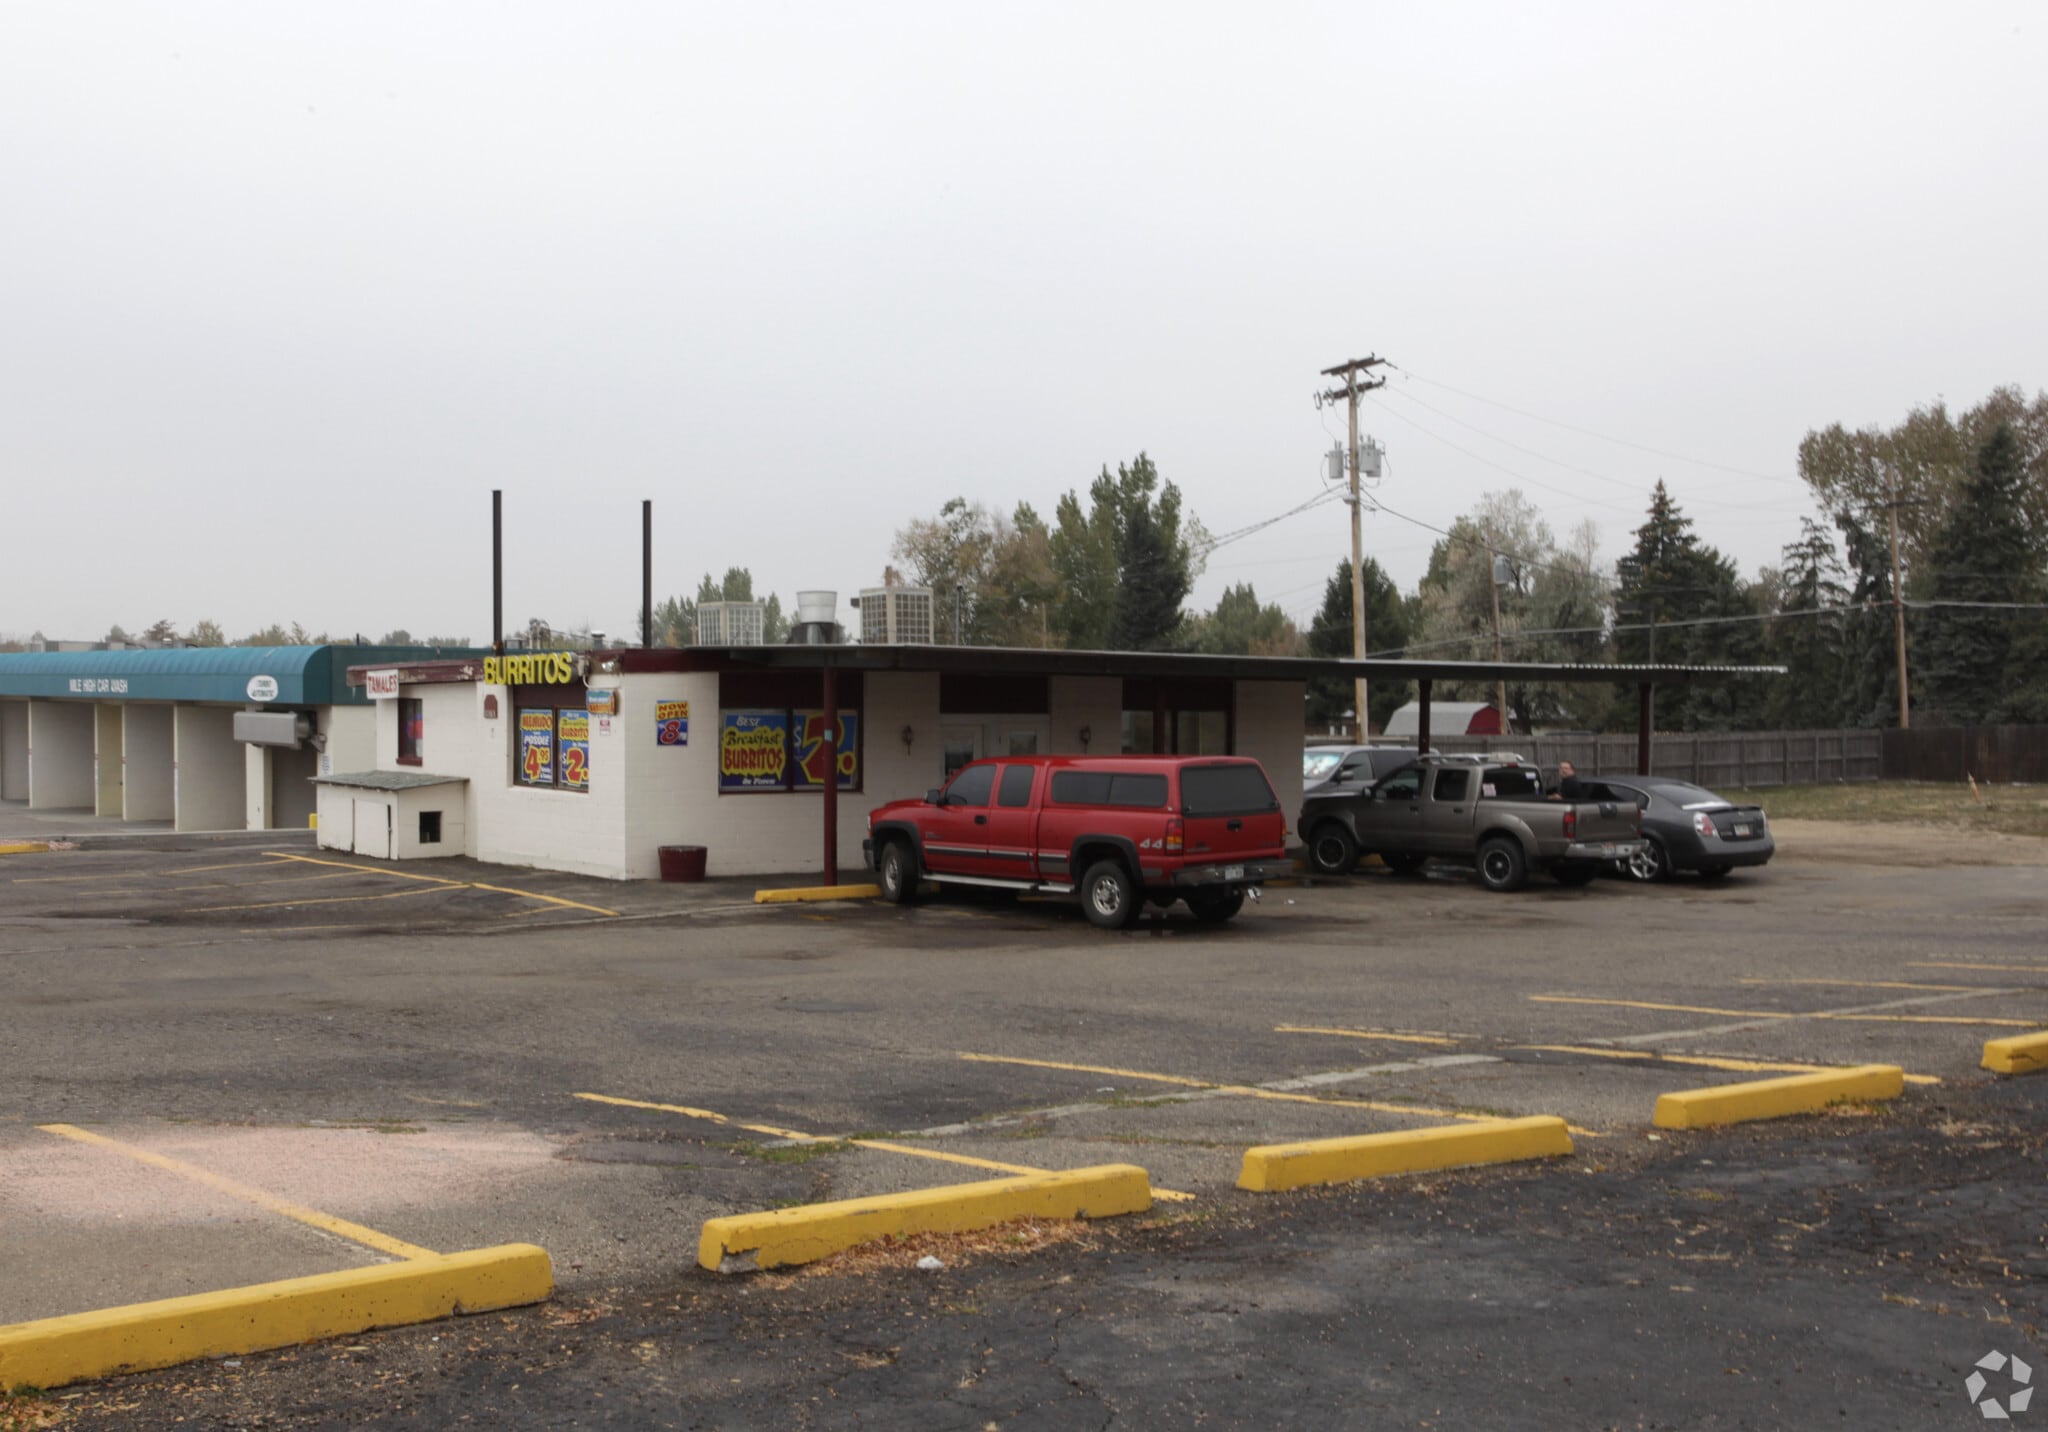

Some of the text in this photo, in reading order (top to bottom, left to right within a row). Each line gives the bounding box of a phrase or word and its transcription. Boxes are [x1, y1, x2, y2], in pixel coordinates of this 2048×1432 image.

[484, 652, 572, 685] BURRITOS
[97, 679, 109, 692] CAR
[368, 675, 397, 693] TAMALES
[658, 702, 687, 711] NOW
[658, 710, 688, 719] OPEN
[661, 720, 680, 743] 8
[726, 730, 780, 746] Breakfast
[724, 747, 783, 770] BURRITOS
